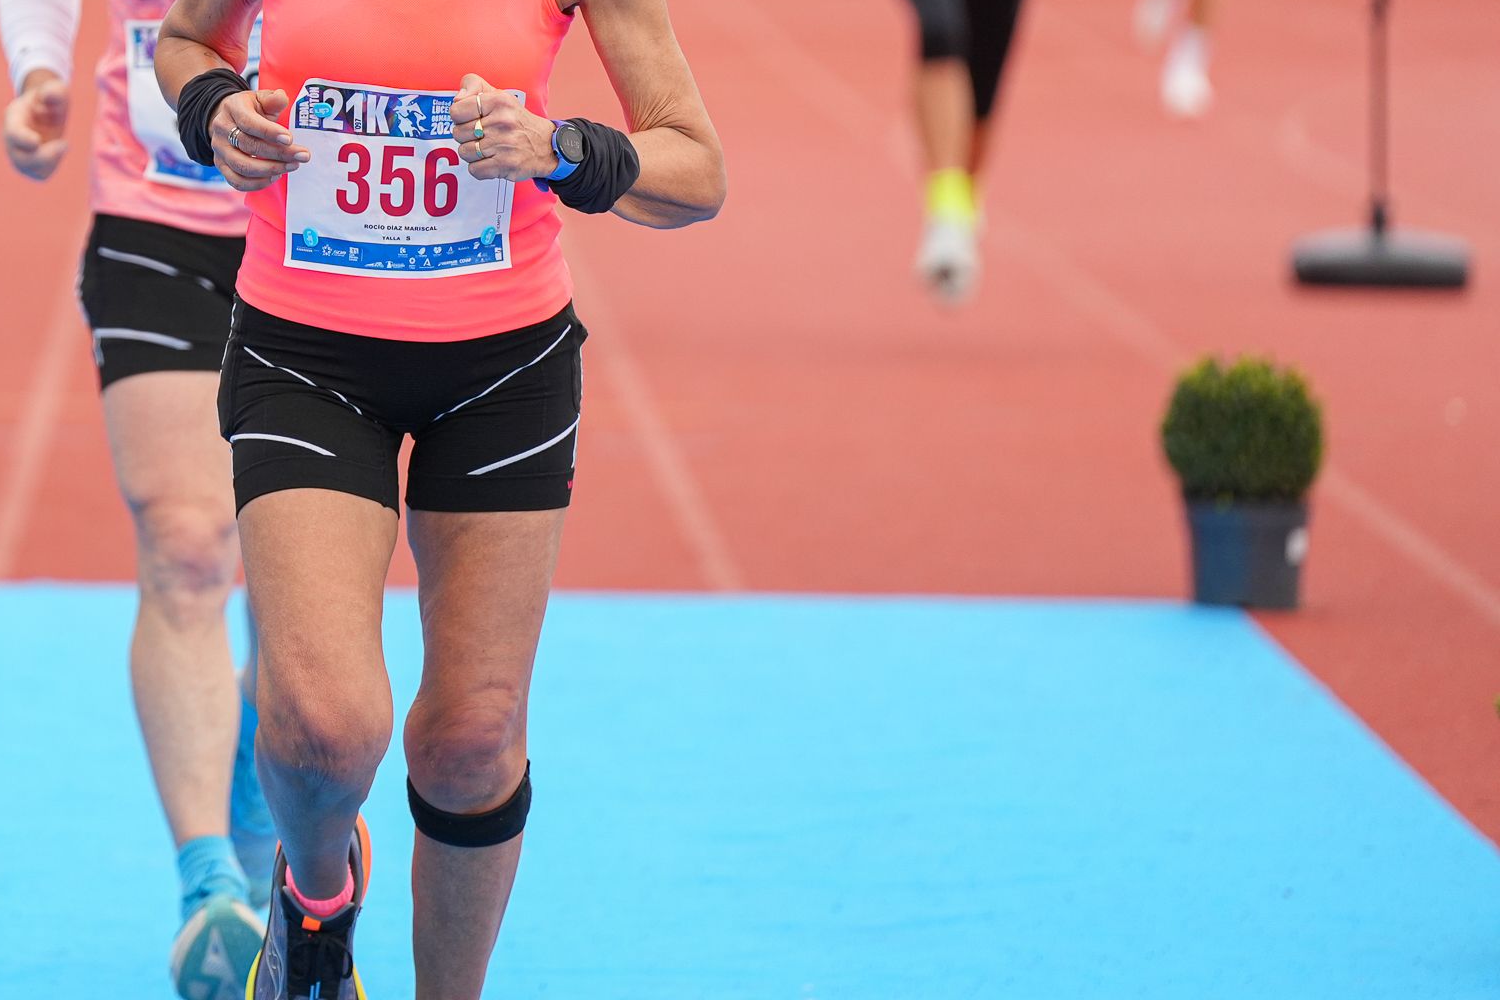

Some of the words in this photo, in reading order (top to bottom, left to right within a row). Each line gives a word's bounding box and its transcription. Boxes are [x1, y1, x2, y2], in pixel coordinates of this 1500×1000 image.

[299, 100, 310, 126] MEDIA
[323, 88, 390, 134] 21K
[431, 105, 451, 114] LUCE
[336, 142, 460, 217] 356
[363, 223, 385, 231] ROCÍO
